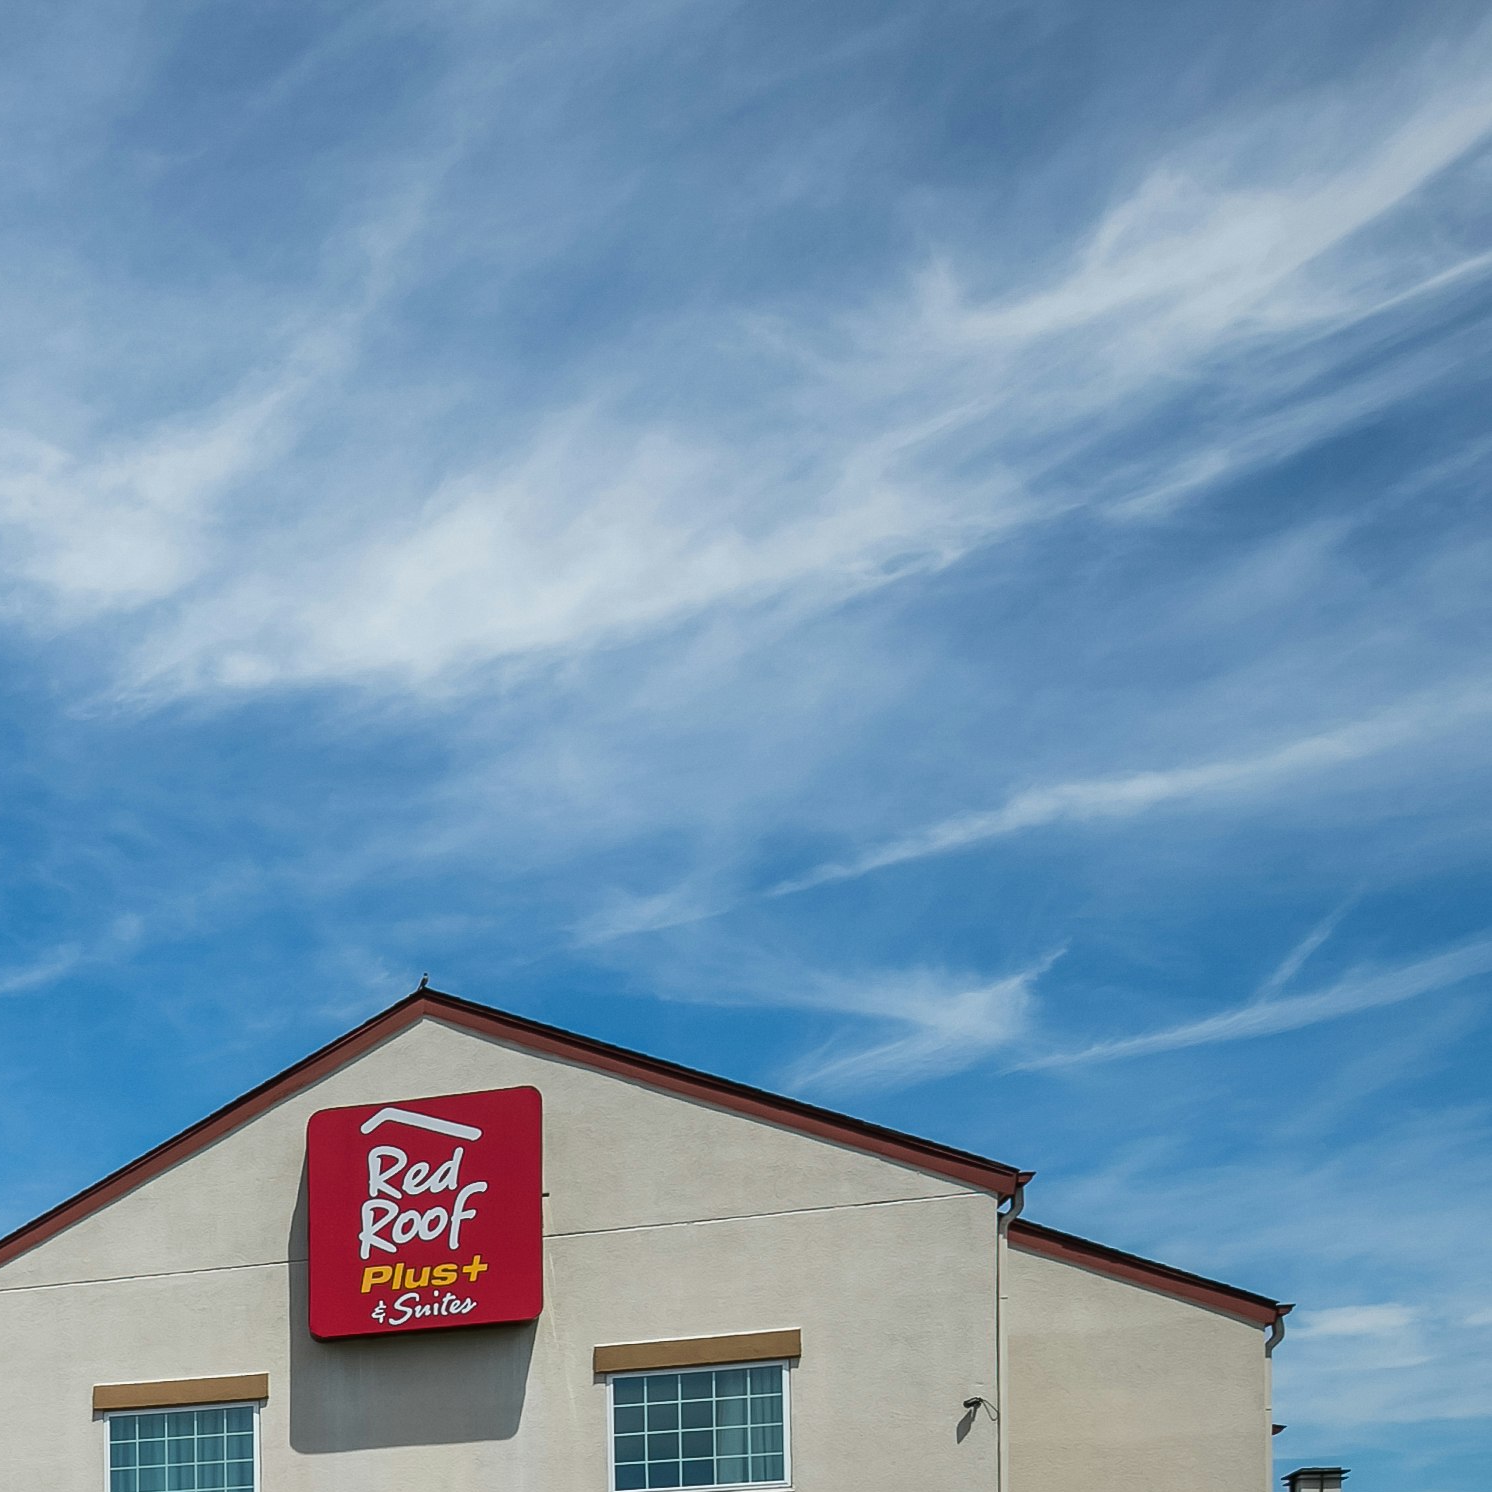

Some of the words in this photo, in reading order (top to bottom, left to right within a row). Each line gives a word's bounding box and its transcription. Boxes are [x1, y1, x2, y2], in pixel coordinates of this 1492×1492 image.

[368, 1145, 464, 1199] Red
[358, 1181, 488, 1260] Roof
[360, 1254, 489, 1294] Plus+
[371, 1300, 387, 1324] &
[388, 1290, 477, 1326] Suites
